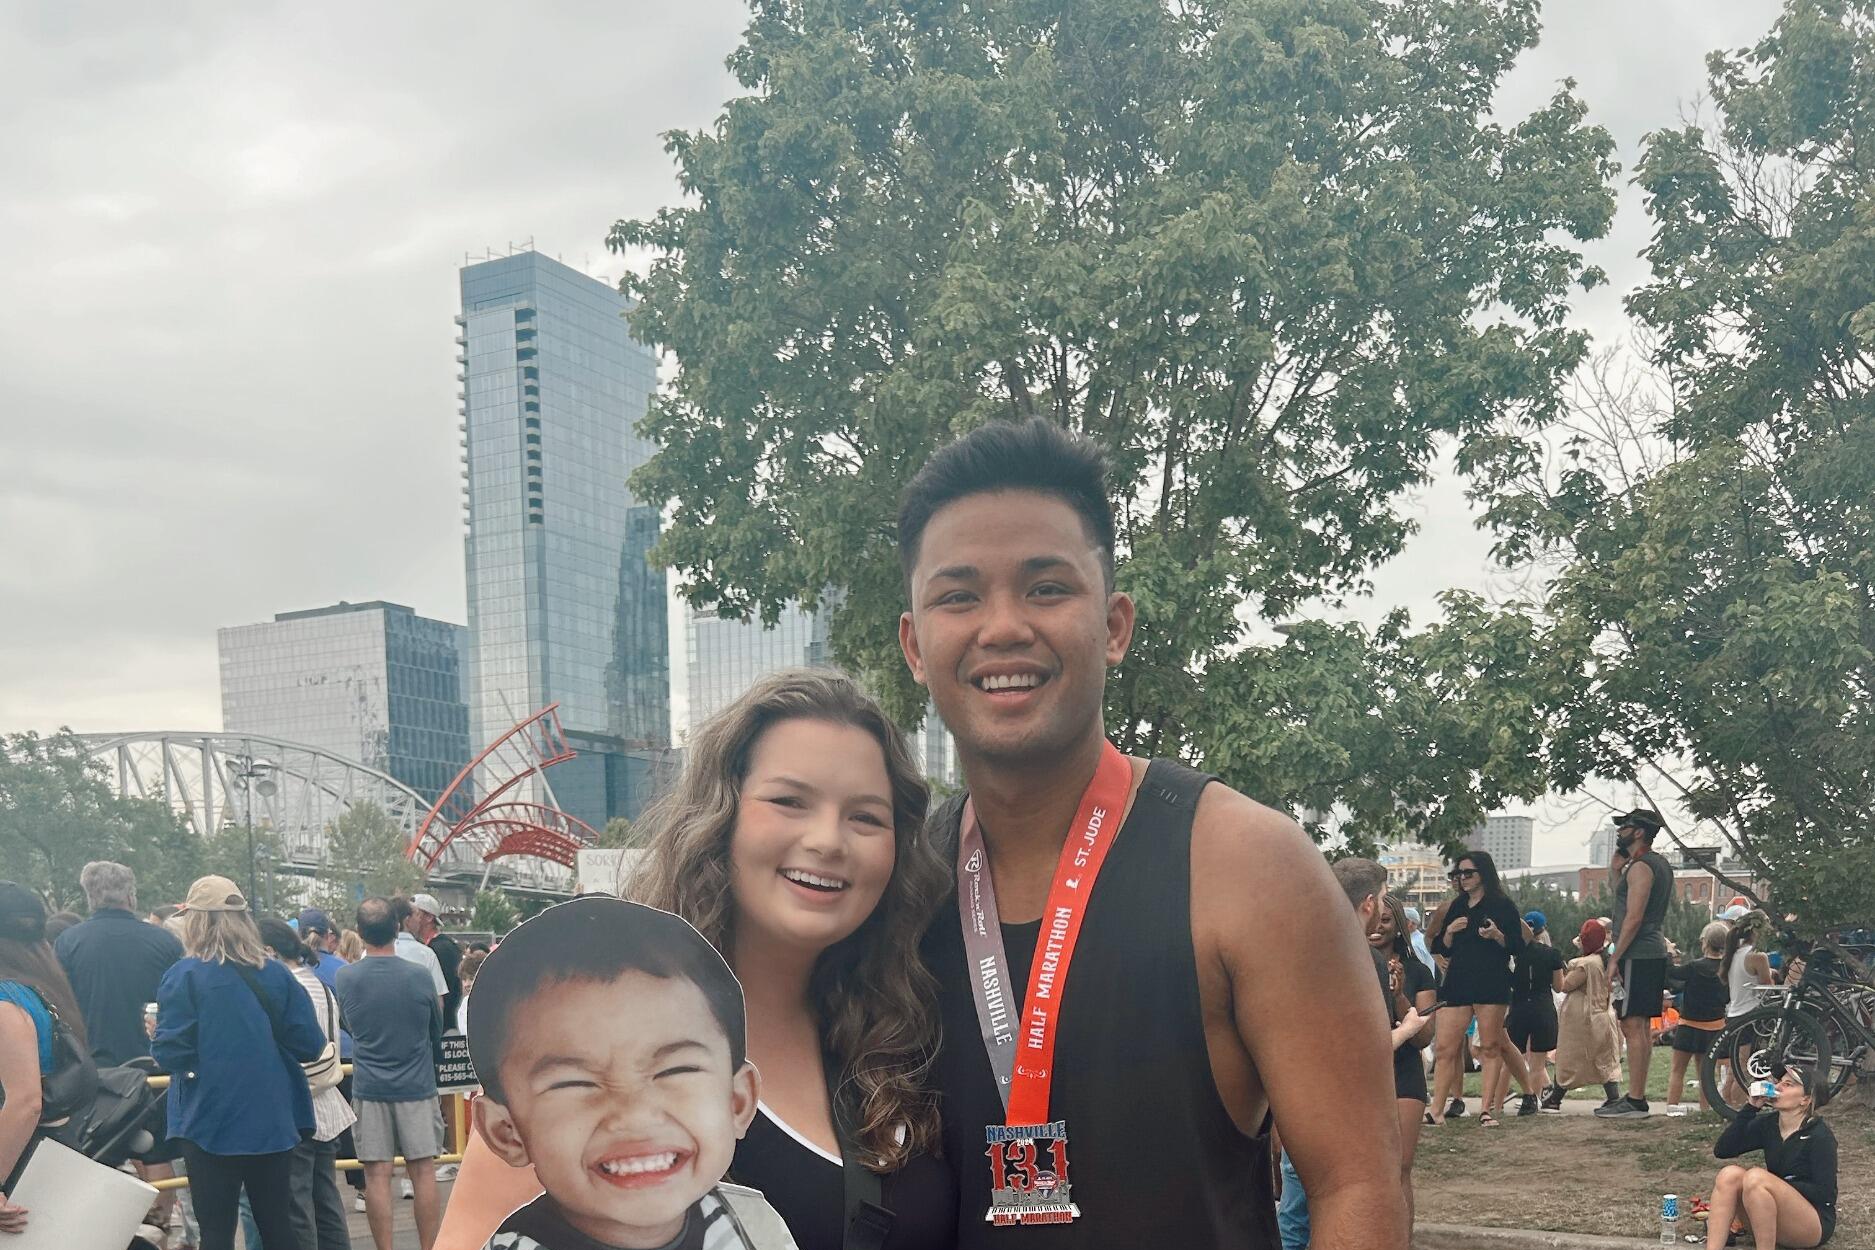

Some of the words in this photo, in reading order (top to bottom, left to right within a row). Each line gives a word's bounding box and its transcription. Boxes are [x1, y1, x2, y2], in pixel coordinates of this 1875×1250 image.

[1084, 806, 1106, 846] JUDE
[1036, 906, 1073, 999] MARATHON
[980, 955, 1012, 1046] NASHVILLE
[1028, 1006, 1047, 1050] HALF
[441, 1041, 448, 1050] IF
[449, 1041, 465, 1049] THIS
[444, 1050, 452, 1059] IS
[439, 1063, 466, 1073] PLEASE
[986, 1121, 1067, 1143] NASHVILLE
[993, 1213, 1017, 1226] HALF
[1020, 1211, 1074, 1224] MARATHON
